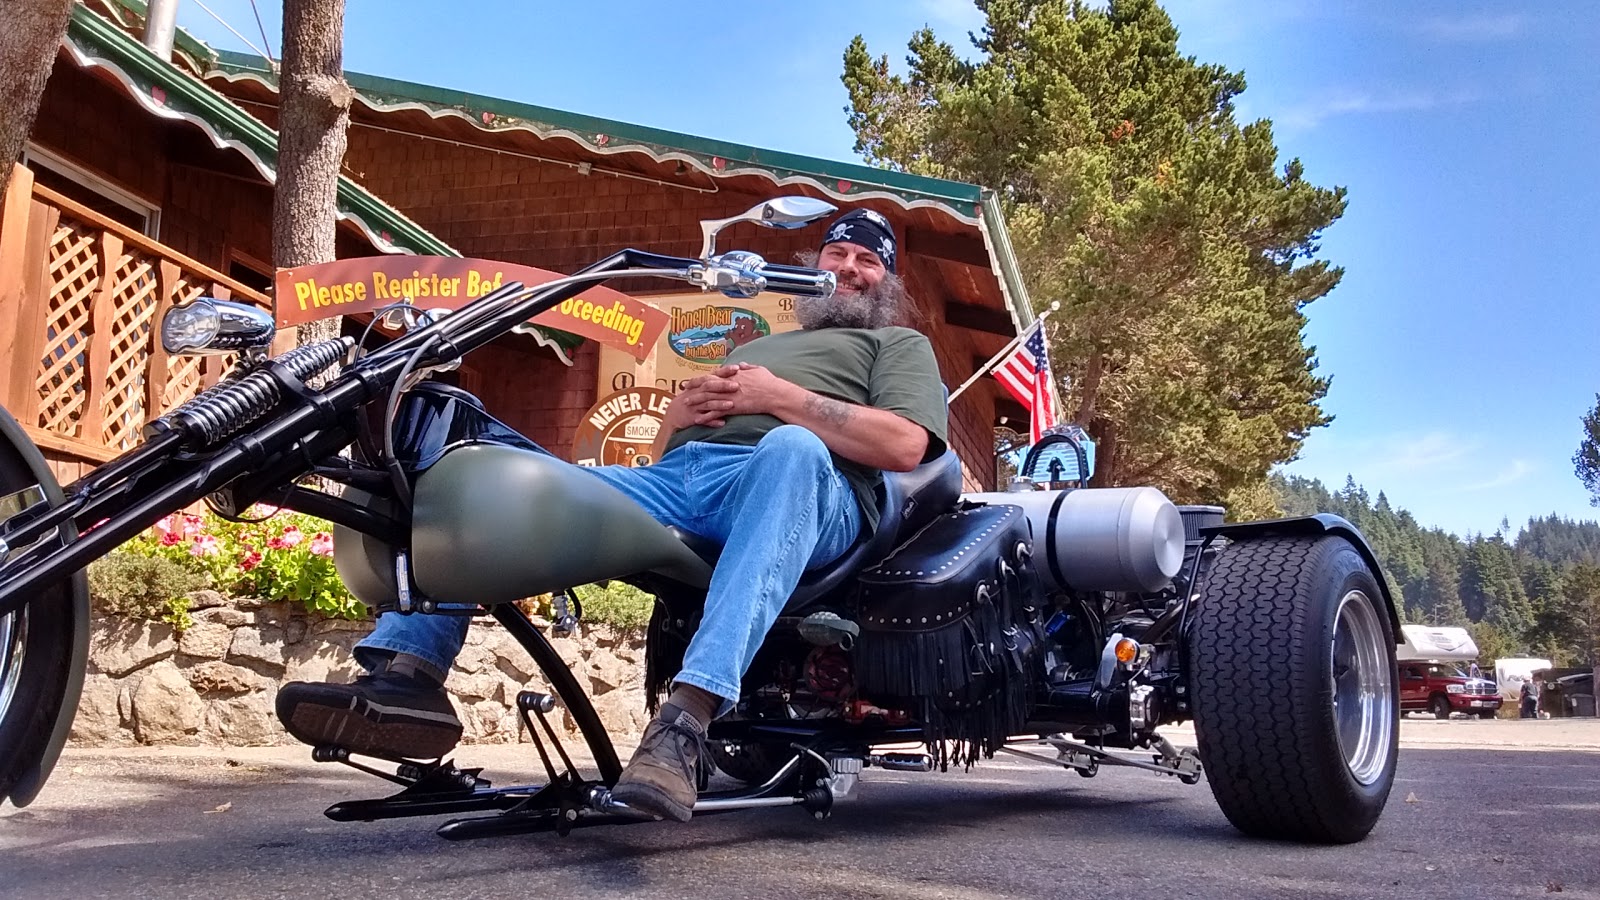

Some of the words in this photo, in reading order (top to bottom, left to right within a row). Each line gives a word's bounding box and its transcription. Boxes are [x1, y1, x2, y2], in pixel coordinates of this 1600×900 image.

[295, 278, 367, 310] Please
[373, 270, 461, 304] Register
[551, 297, 645, 346] oceeding
[671, 306, 706, 336] Honey
[706, 305, 733, 328] Bear
[708, 342, 726, 360] Sea
[589, 392, 642, 431] NEVER
